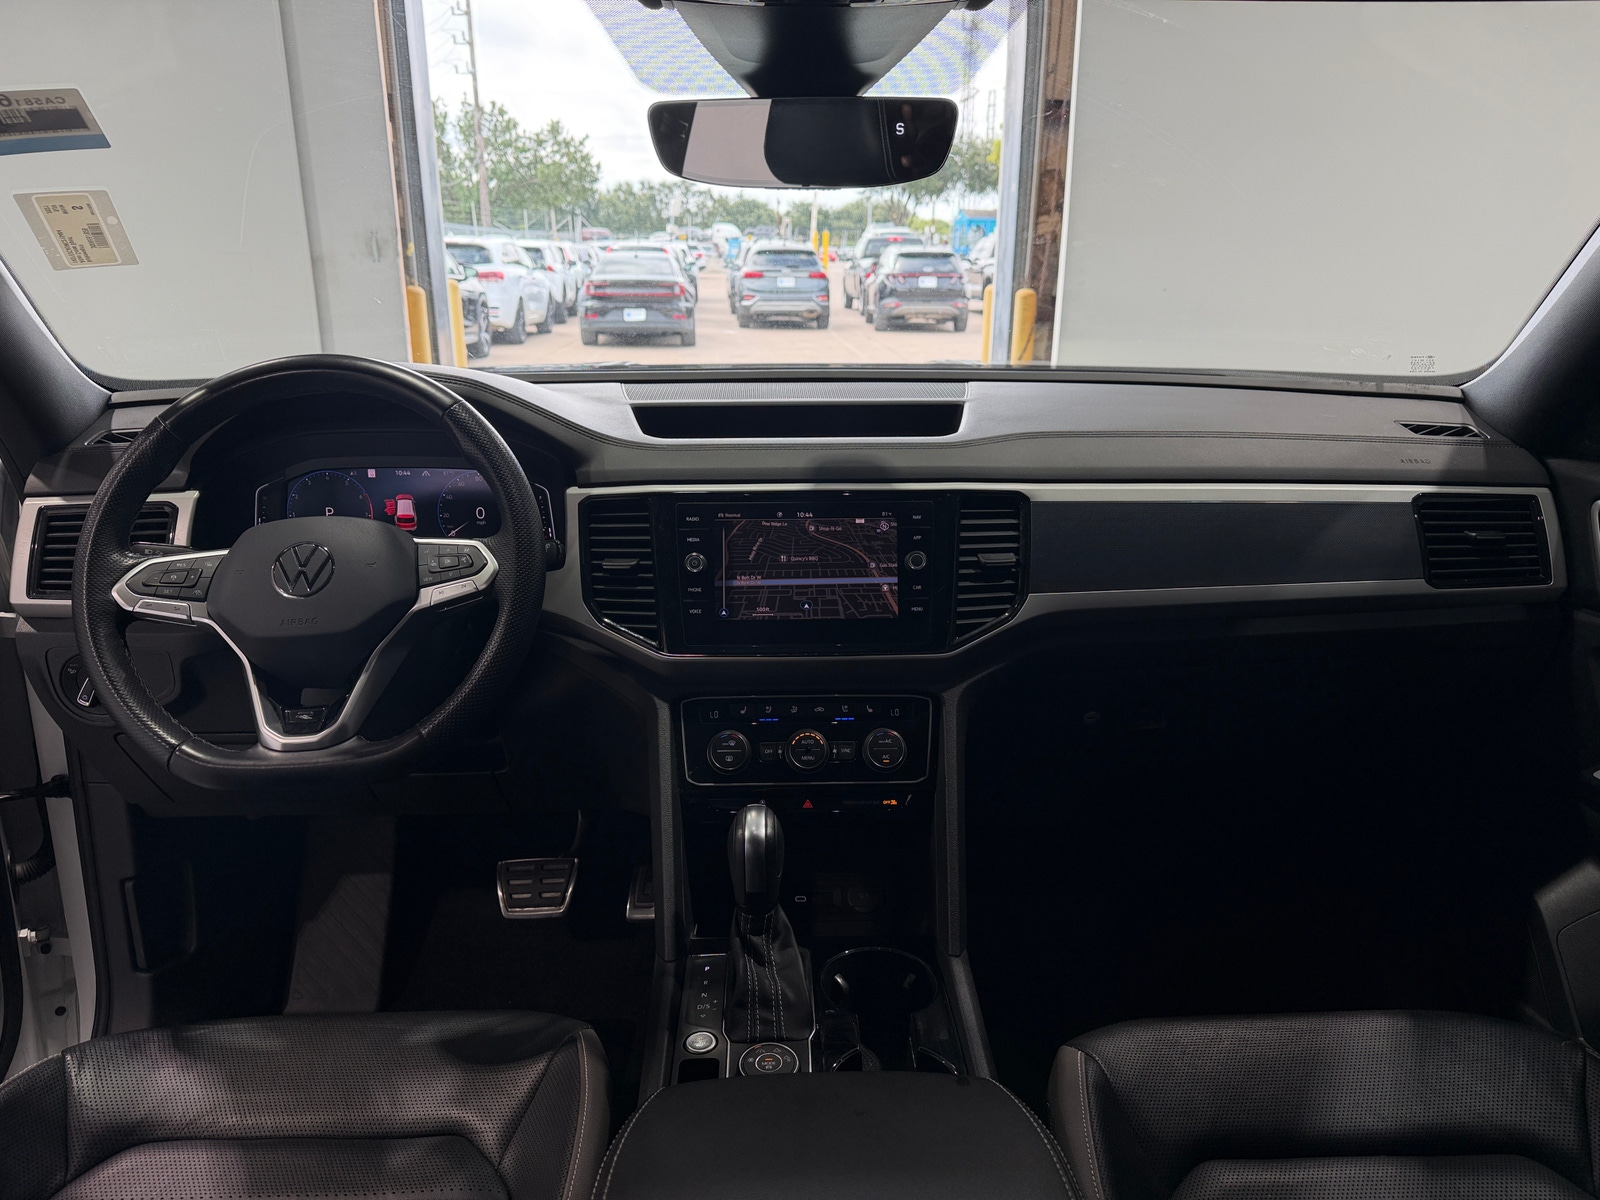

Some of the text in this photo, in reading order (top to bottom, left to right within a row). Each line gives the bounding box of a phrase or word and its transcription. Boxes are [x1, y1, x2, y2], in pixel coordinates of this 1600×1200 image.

[895, 122, 905, 136] S
[325, 506, 335, 517] P
[475, 506, 486, 520] 0
[280, 616, 318, 626] AIRBAG
